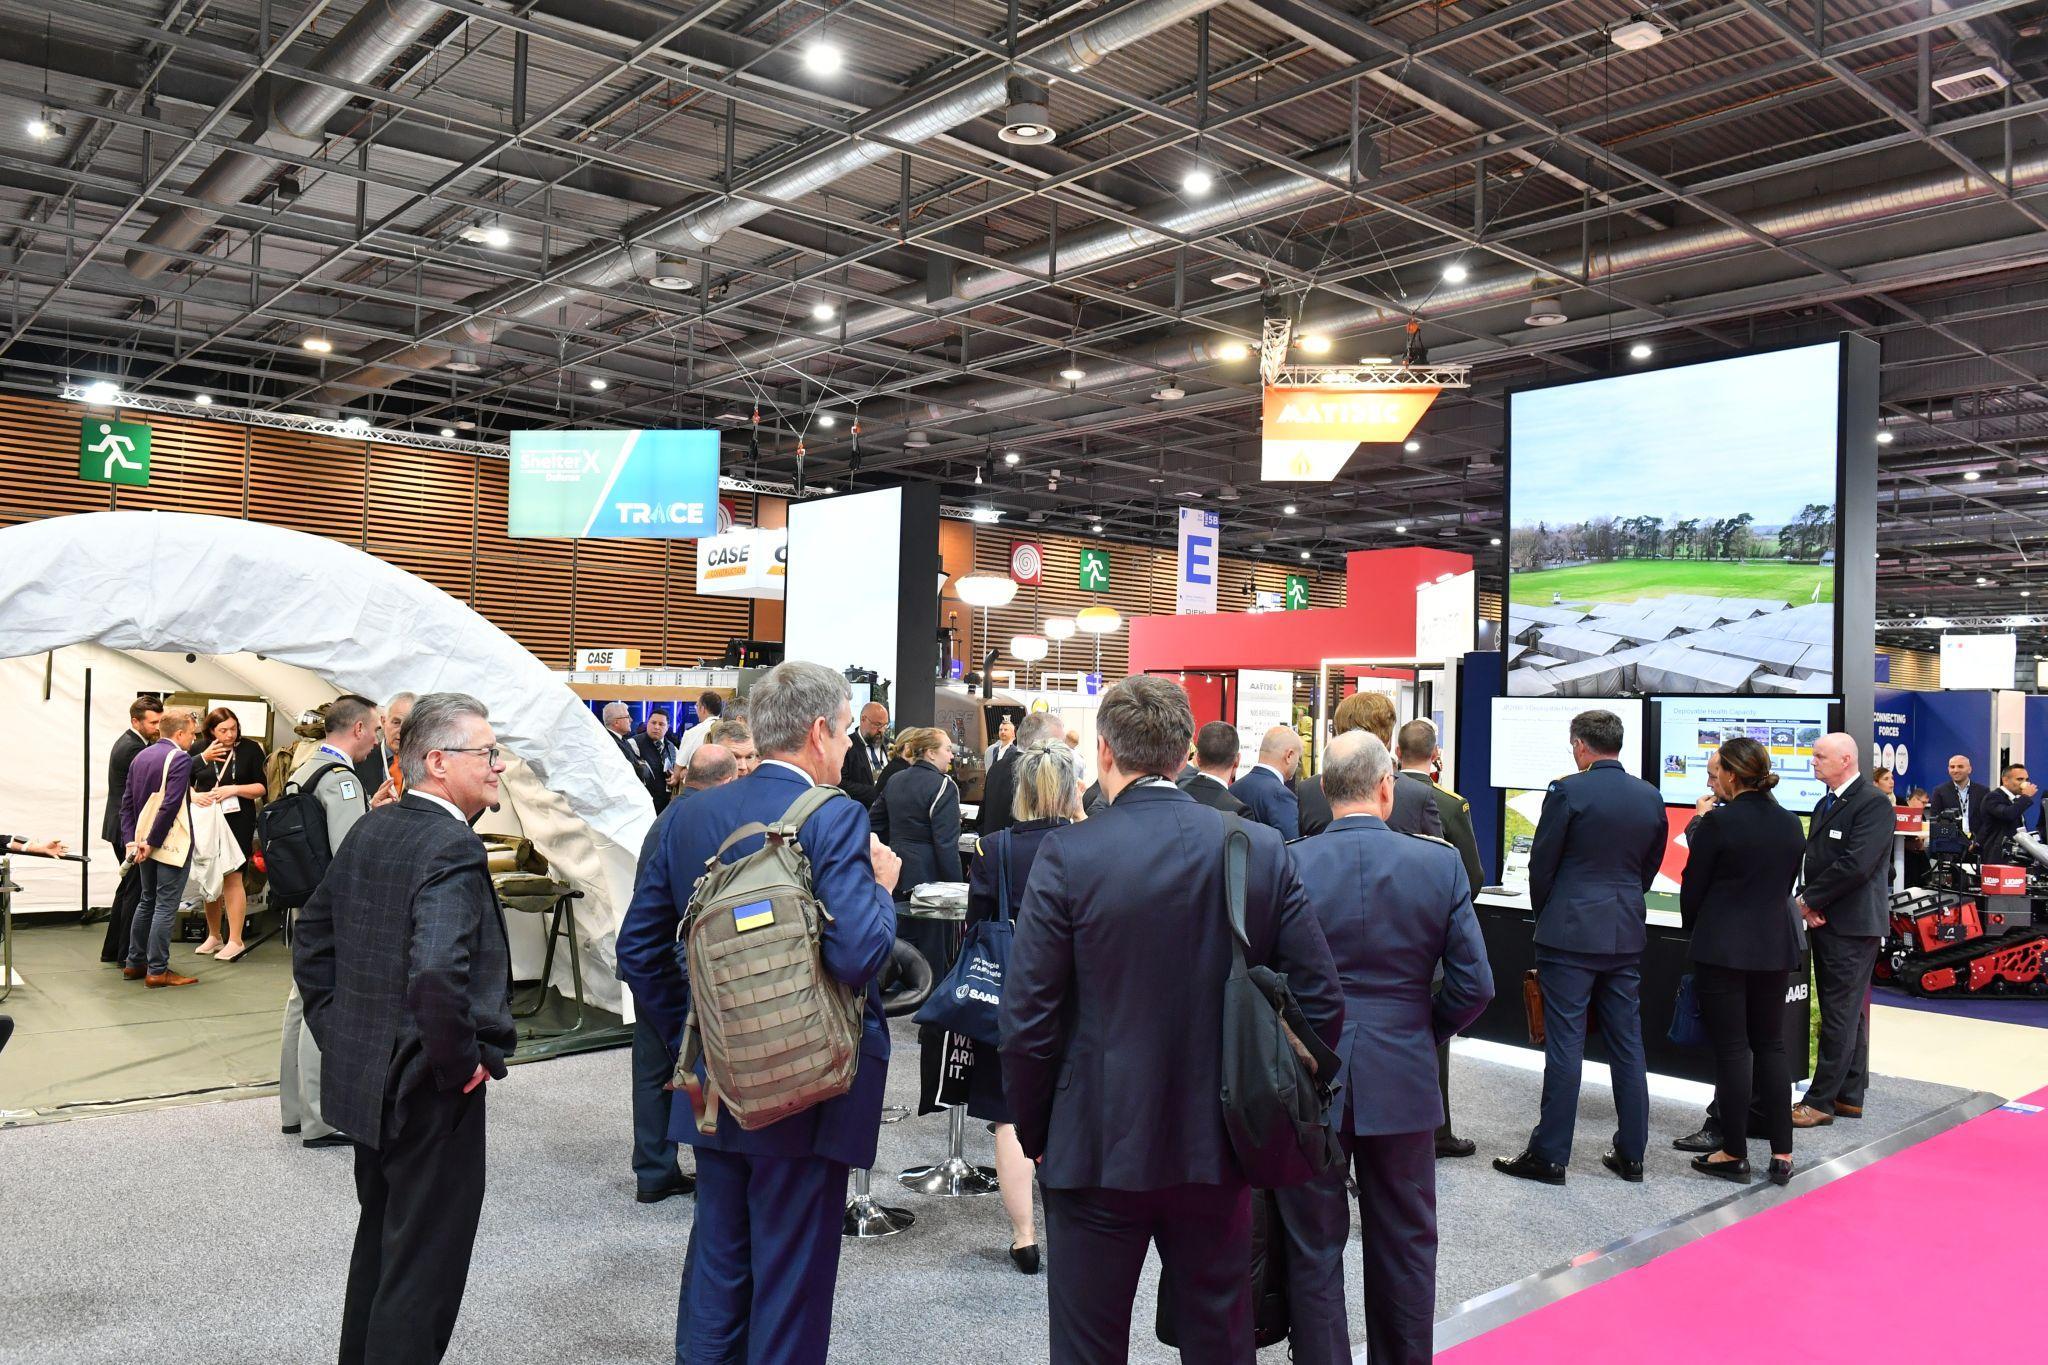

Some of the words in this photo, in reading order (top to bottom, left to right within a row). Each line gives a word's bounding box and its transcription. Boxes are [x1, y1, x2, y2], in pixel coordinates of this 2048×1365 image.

[615, 501, 704, 524] TRACE
[707, 544, 750, 567] CASE
[1186, 534, 1212, 585] E
[587, 652, 613, 664] CASE
[1878, 726, 1899, 737] FORCES
[968, 988, 999, 1005] SAAB
[1785, 983, 1808, 1003] AAB
[949, 1065, 965, 1080] IT.
